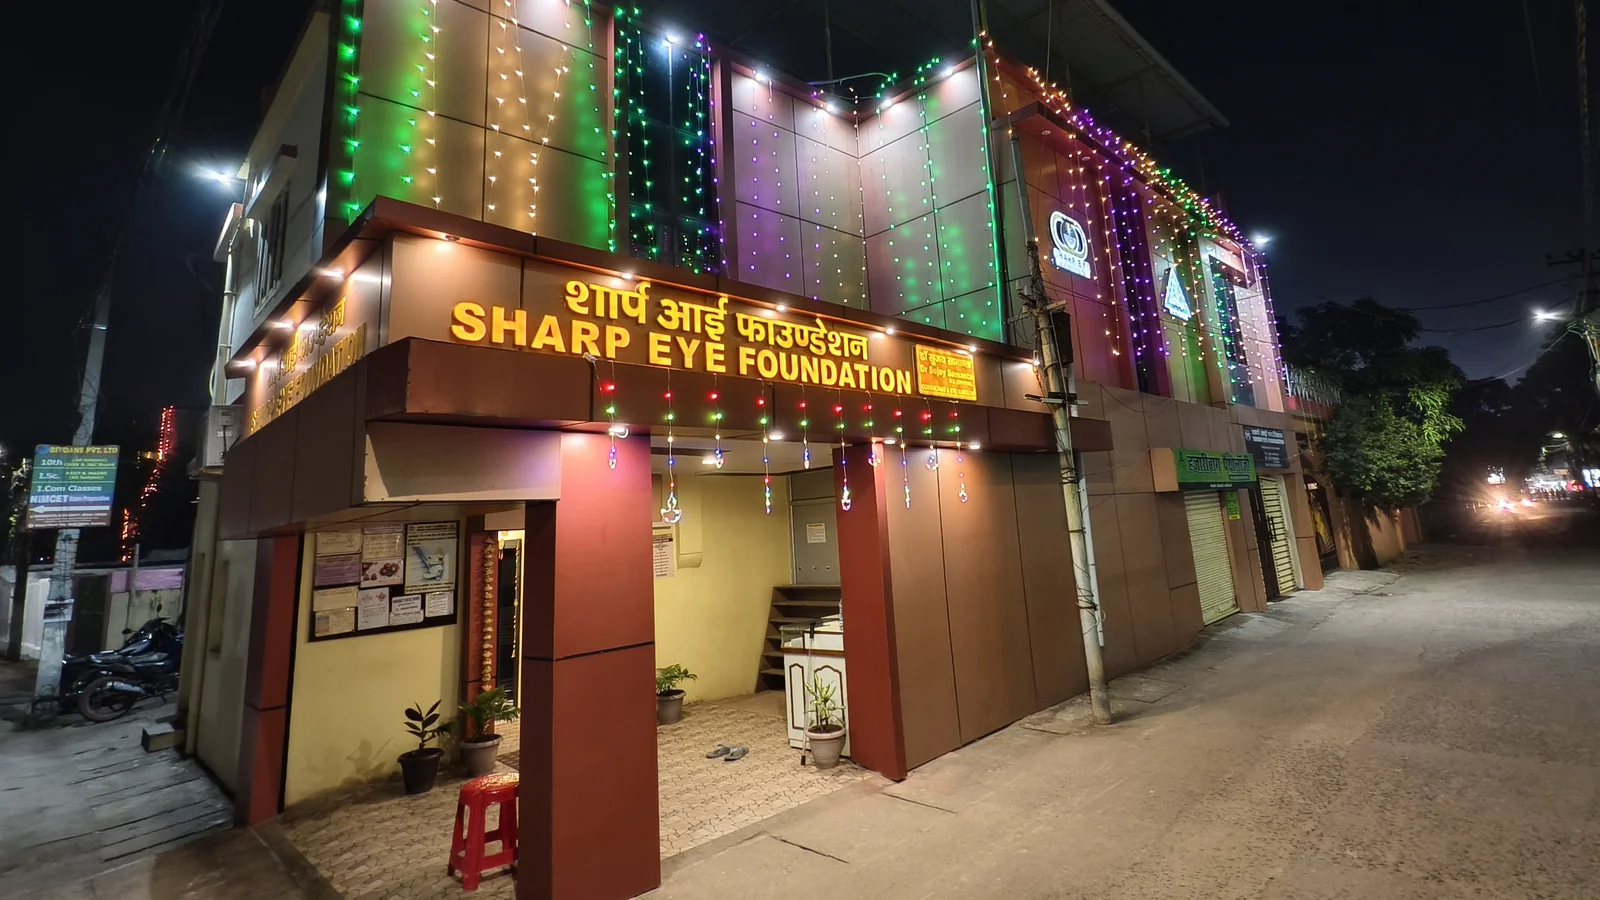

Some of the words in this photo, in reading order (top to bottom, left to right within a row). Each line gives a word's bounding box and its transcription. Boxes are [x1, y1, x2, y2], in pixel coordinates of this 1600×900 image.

[451, 301, 631, 359] SHARP
[649, 331, 726, 373] EYE
[739, 346, 912, 395] FOUNDATION
[565, 280, 651, 324] शार्प
[656, 293, 729, 342] आई
[735, 312, 868, 360] फाउण्डेशन
[29, 494, 69, 503] NIMCET
